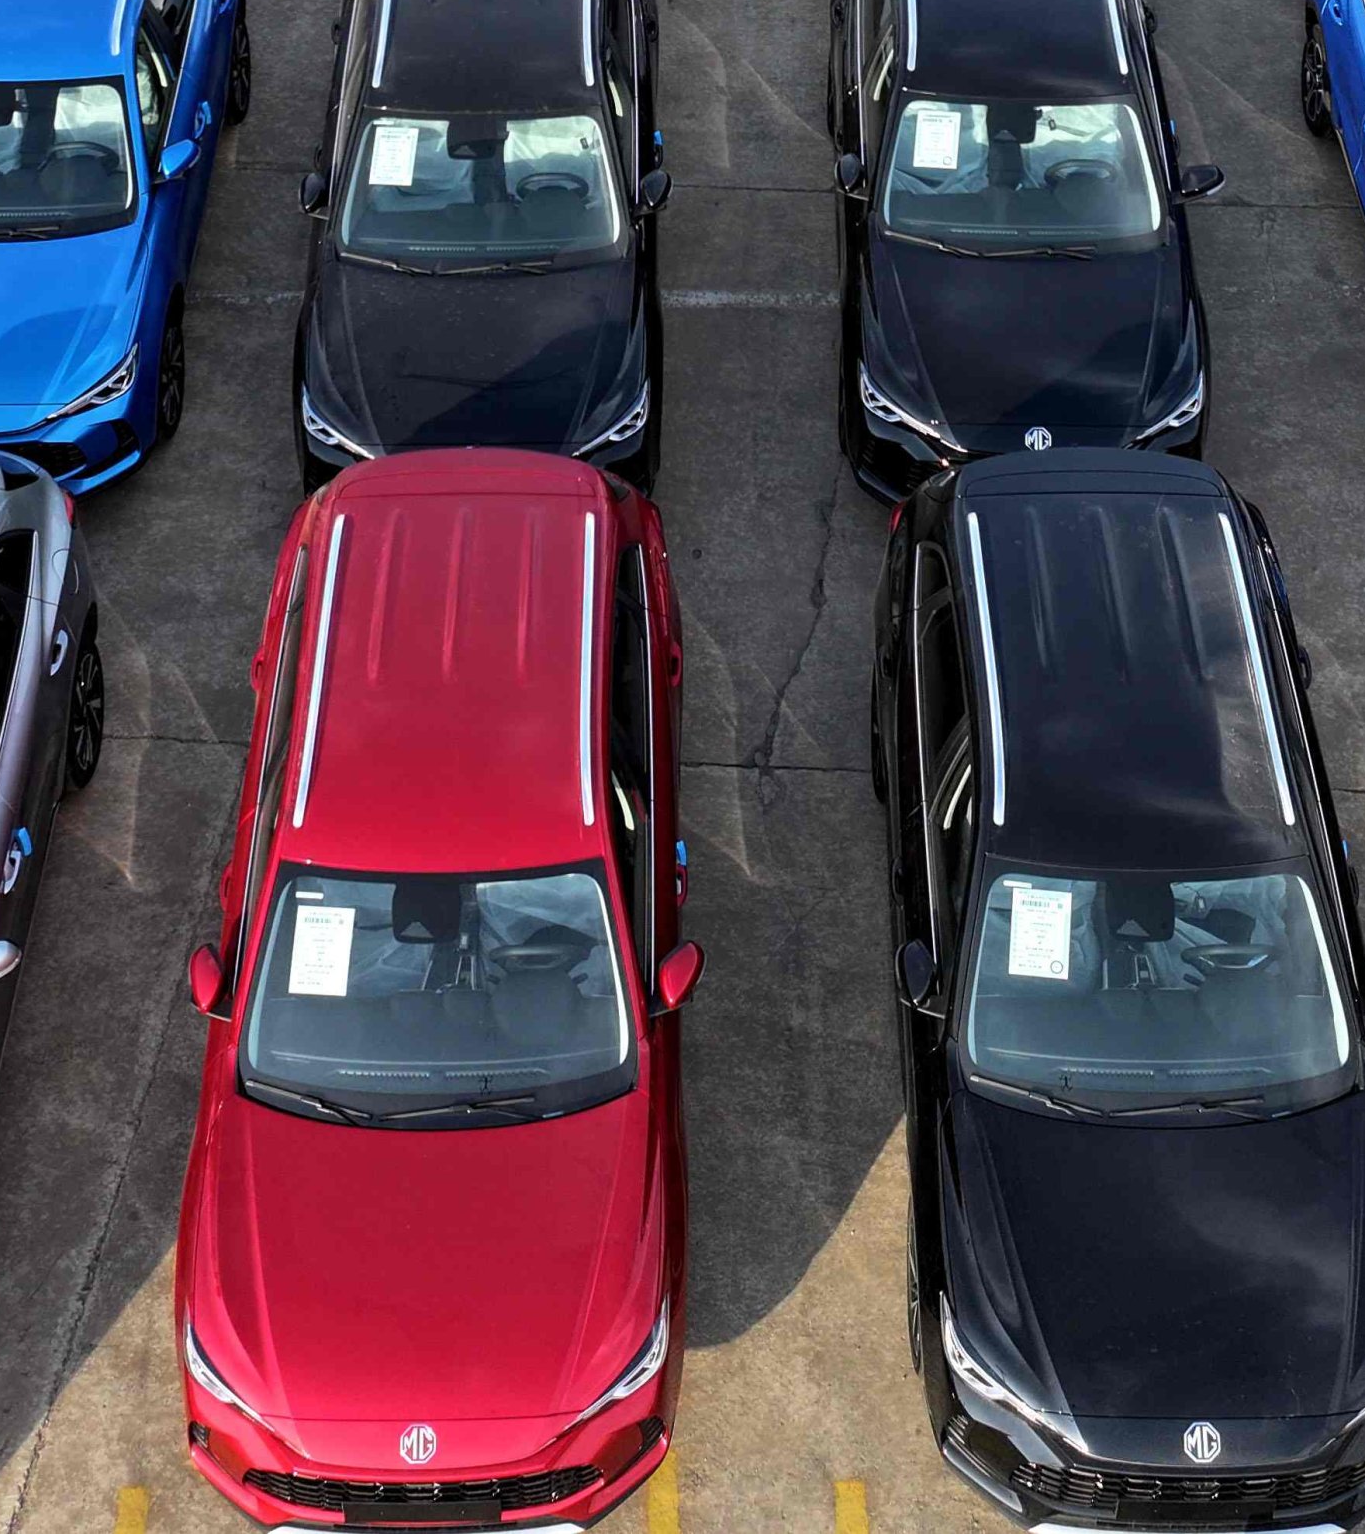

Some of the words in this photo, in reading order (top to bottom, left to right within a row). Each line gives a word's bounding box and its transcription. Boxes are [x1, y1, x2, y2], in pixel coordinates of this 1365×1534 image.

[1027, 429, 1049, 451] MG
[402, 1426, 434, 1461] MG
[1187, 1425, 1218, 1459] MG
